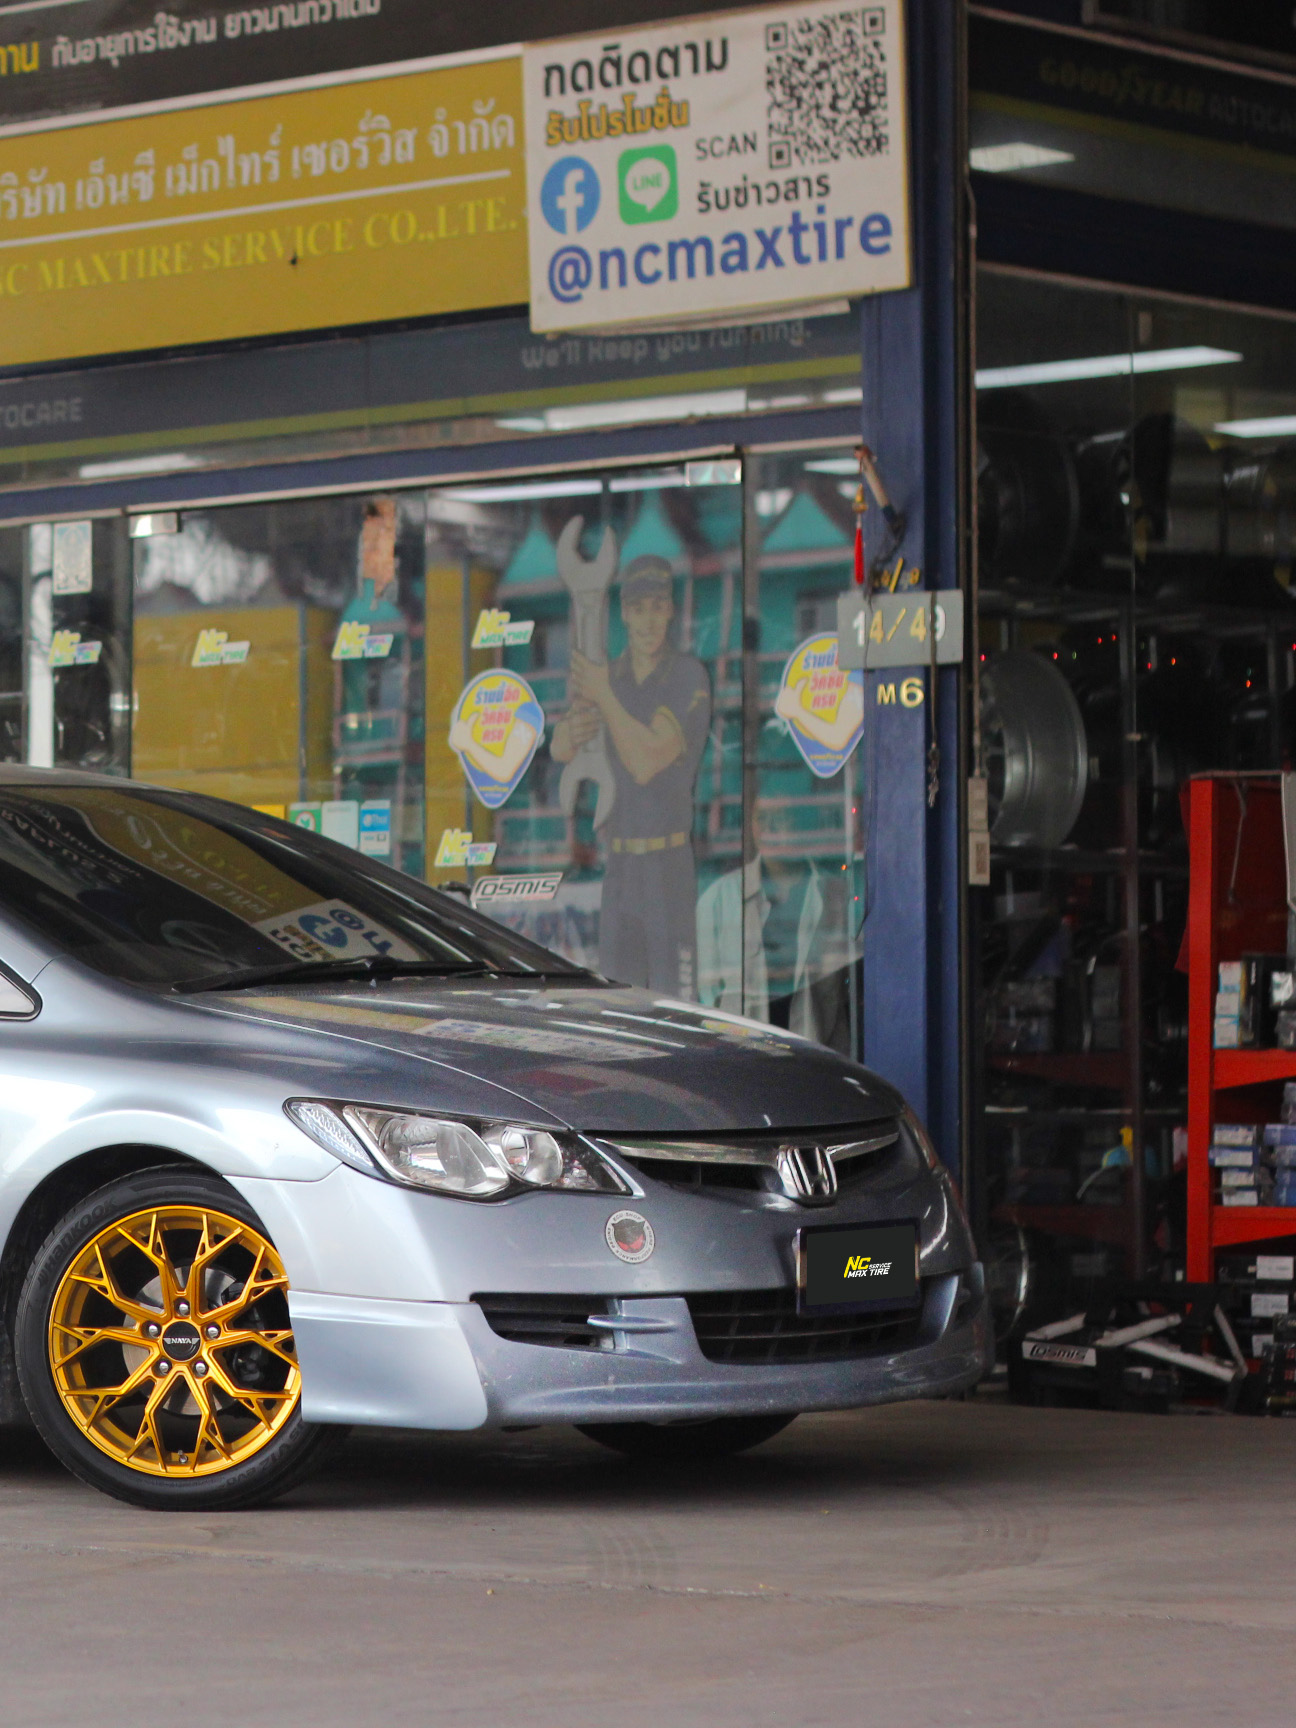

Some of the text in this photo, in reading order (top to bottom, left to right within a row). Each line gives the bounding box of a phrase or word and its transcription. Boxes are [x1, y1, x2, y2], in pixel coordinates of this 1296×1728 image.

[543, 36, 730, 98] กดติดตาม
[427, 98, 516, 159] จำกัด
[545, 87, 690, 147] รับโปรโมชั่น
[695, 132, 758, 161] SCAN
[632, 172, 663, 193] LINE
[696, 174, 831, 215] รับข่าวสาร
[37, 242, 193, 292] MAXTIRE
[202, 218, 354, 271] SERVICE
[547, 204, 893, 304] @ncmaxtire
[655, 331, 700, 361] you
